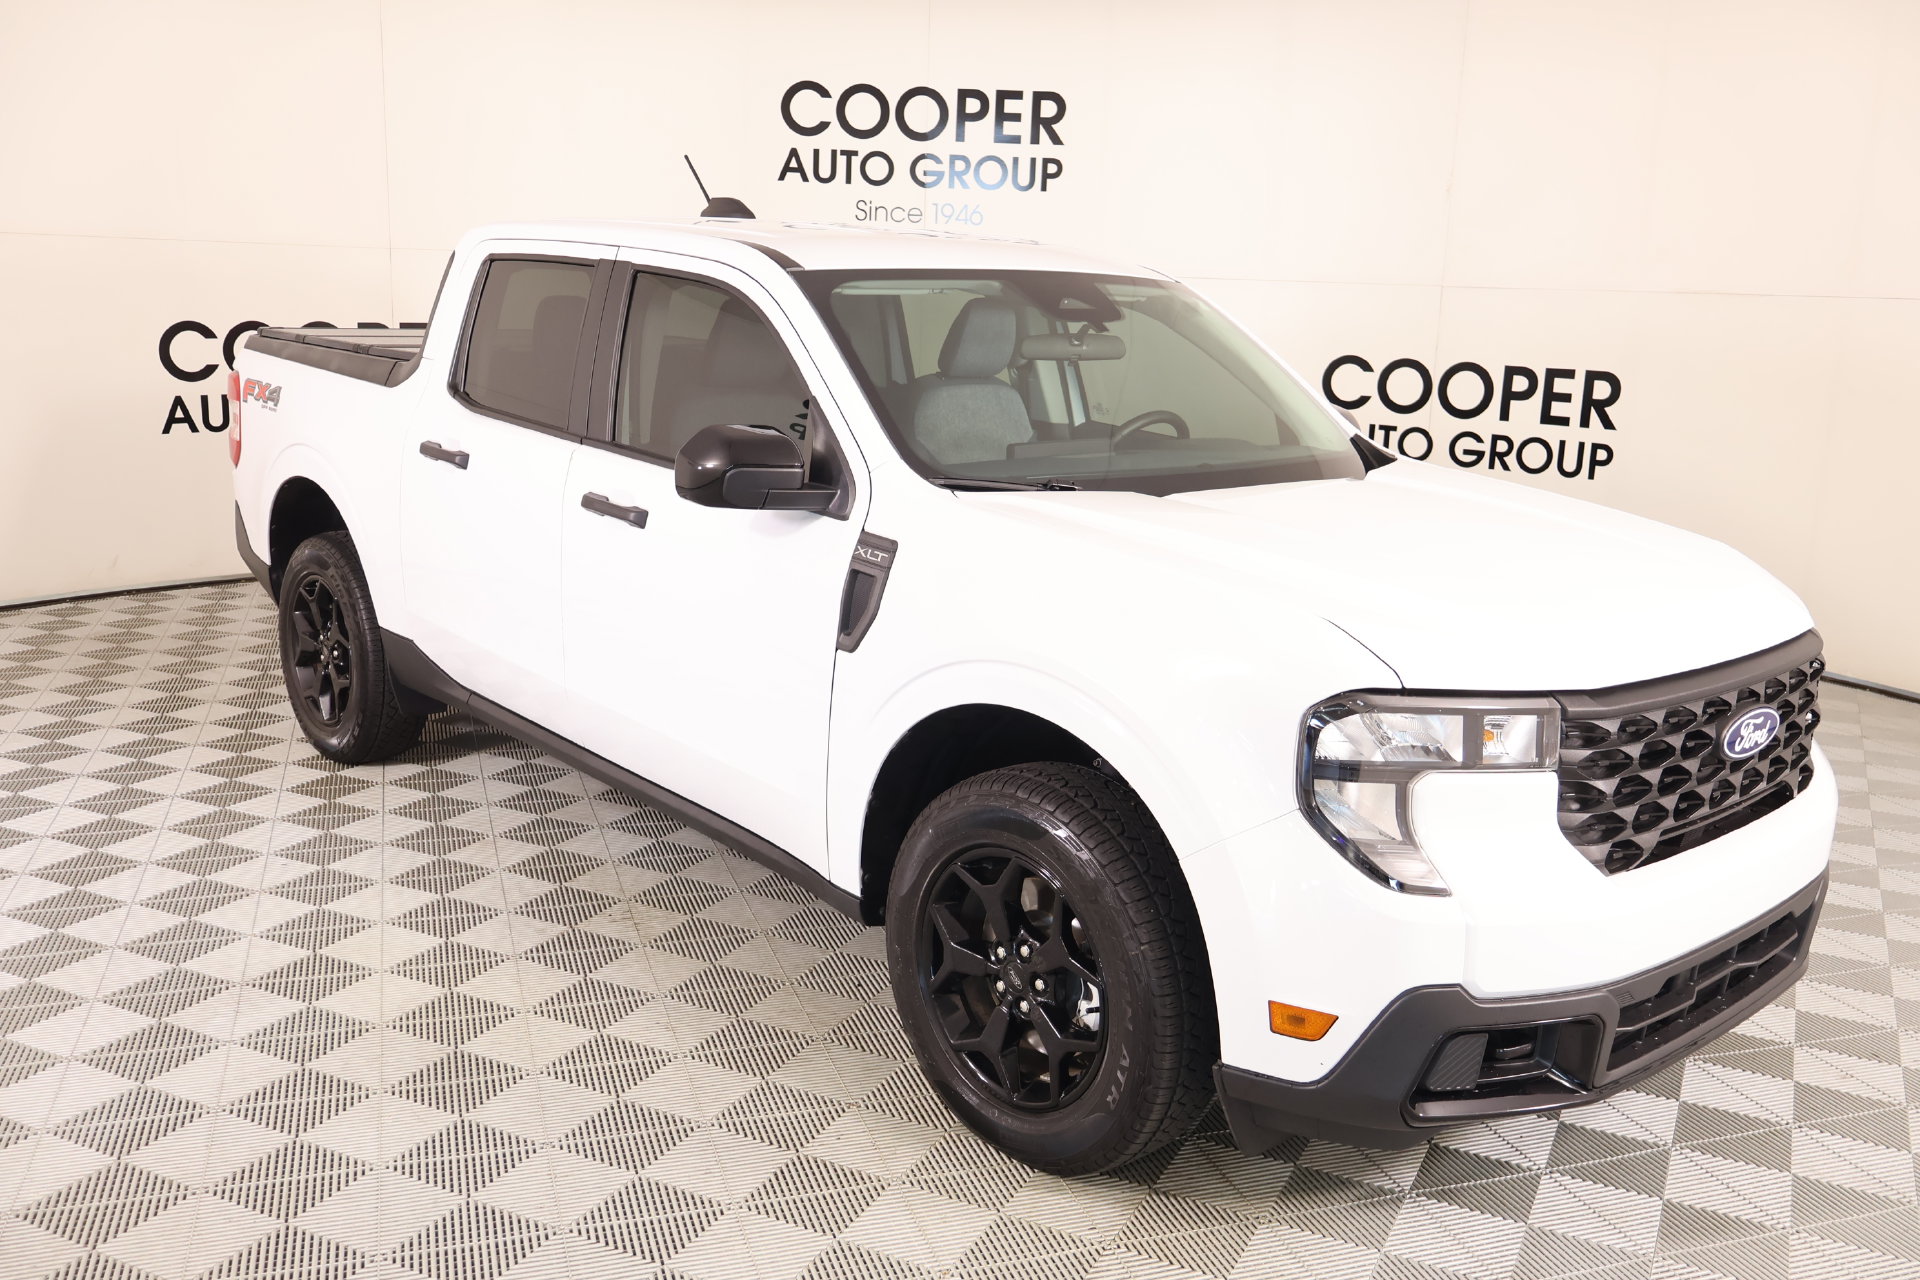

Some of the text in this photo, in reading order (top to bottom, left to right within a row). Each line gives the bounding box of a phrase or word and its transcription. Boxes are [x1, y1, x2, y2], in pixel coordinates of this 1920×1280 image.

[780, 80, 1067, 146] COOPER
[777, 147, 1063, 192] AUTO GROUP
[855, 199, 984, 226] Since 1946
[242, 377, 283, 408] FX4
[1322, 354, 1622, 431] COOPER
[161, 394, 230, 435] AU
[1448, 430, 1614, 481] GROUP
[853, 545, 889, 562] XLT
[1734, 715, 1771, 752] Ford
